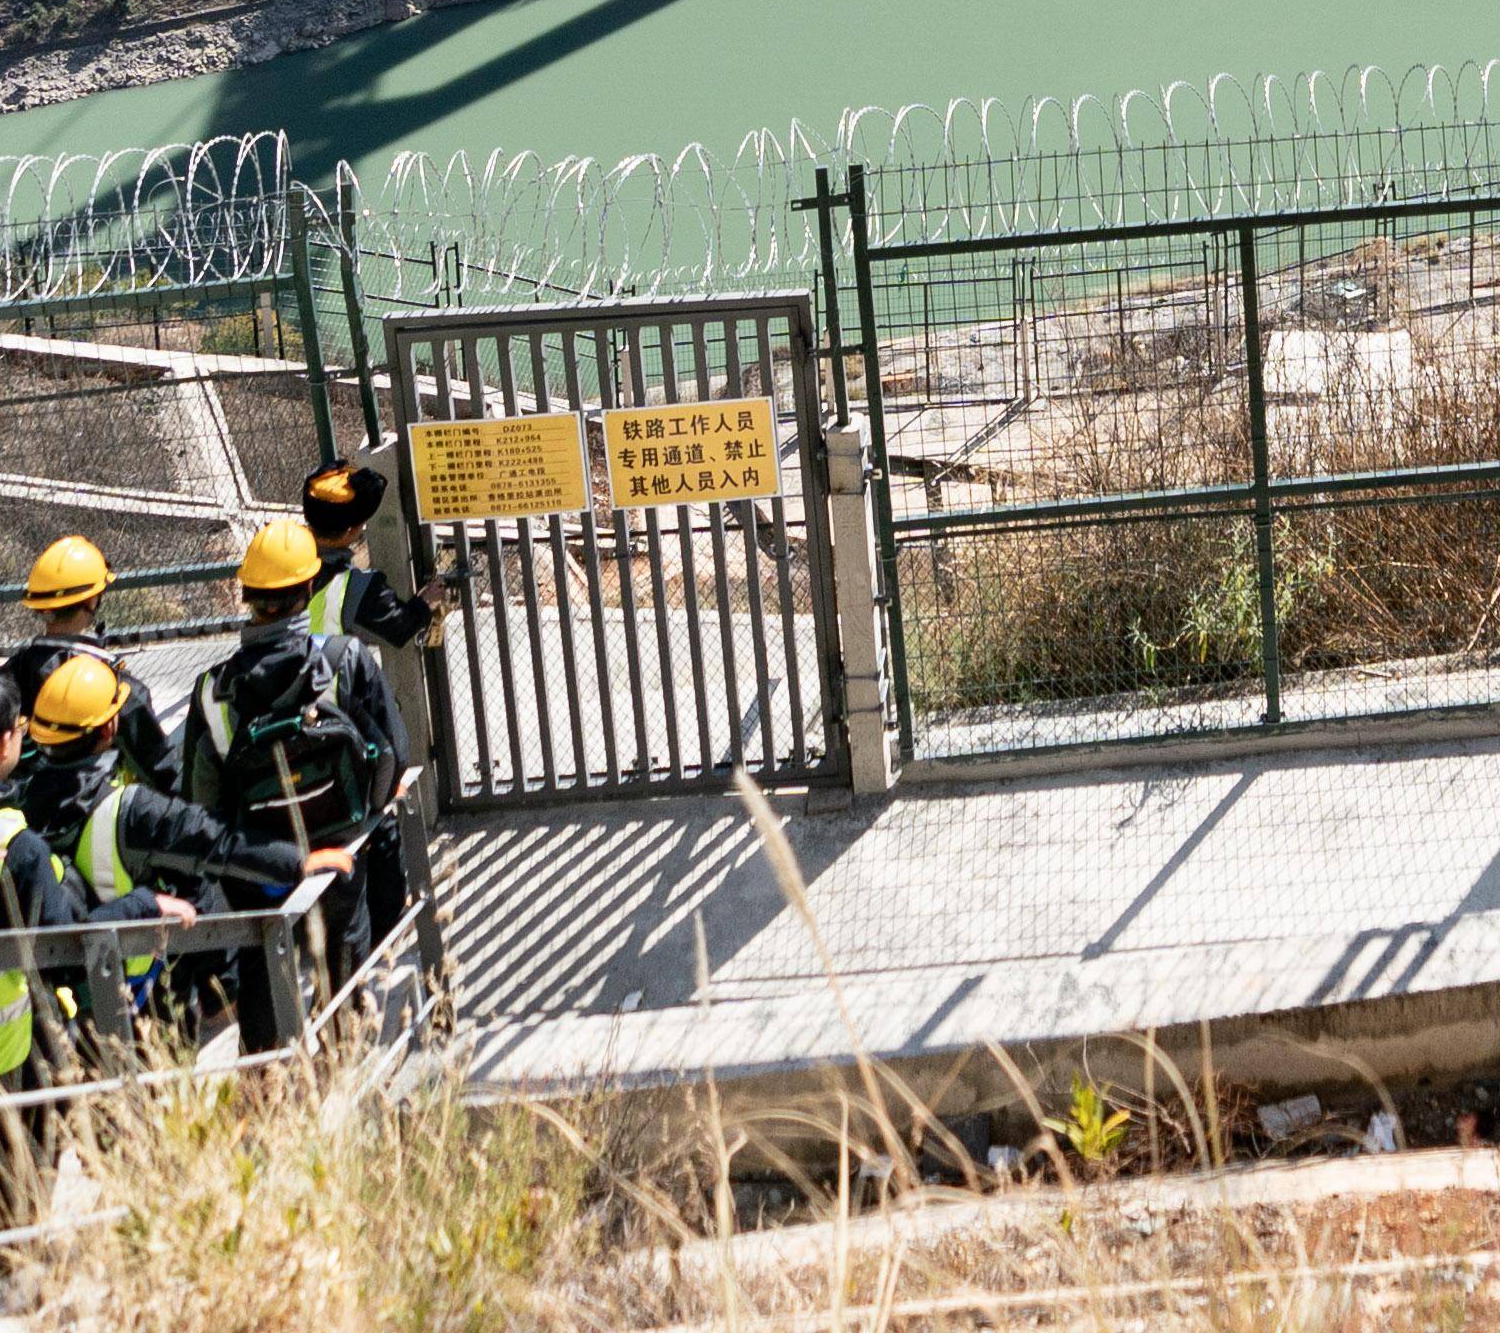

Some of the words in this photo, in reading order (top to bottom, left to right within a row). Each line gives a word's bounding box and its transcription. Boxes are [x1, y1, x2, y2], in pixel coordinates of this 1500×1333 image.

[623, 411, 755, 441] 铁路工作人员
[617, 438, 766, 469] 专用通道、禁止
[629, 466, 760, 497] 其他人员入内
